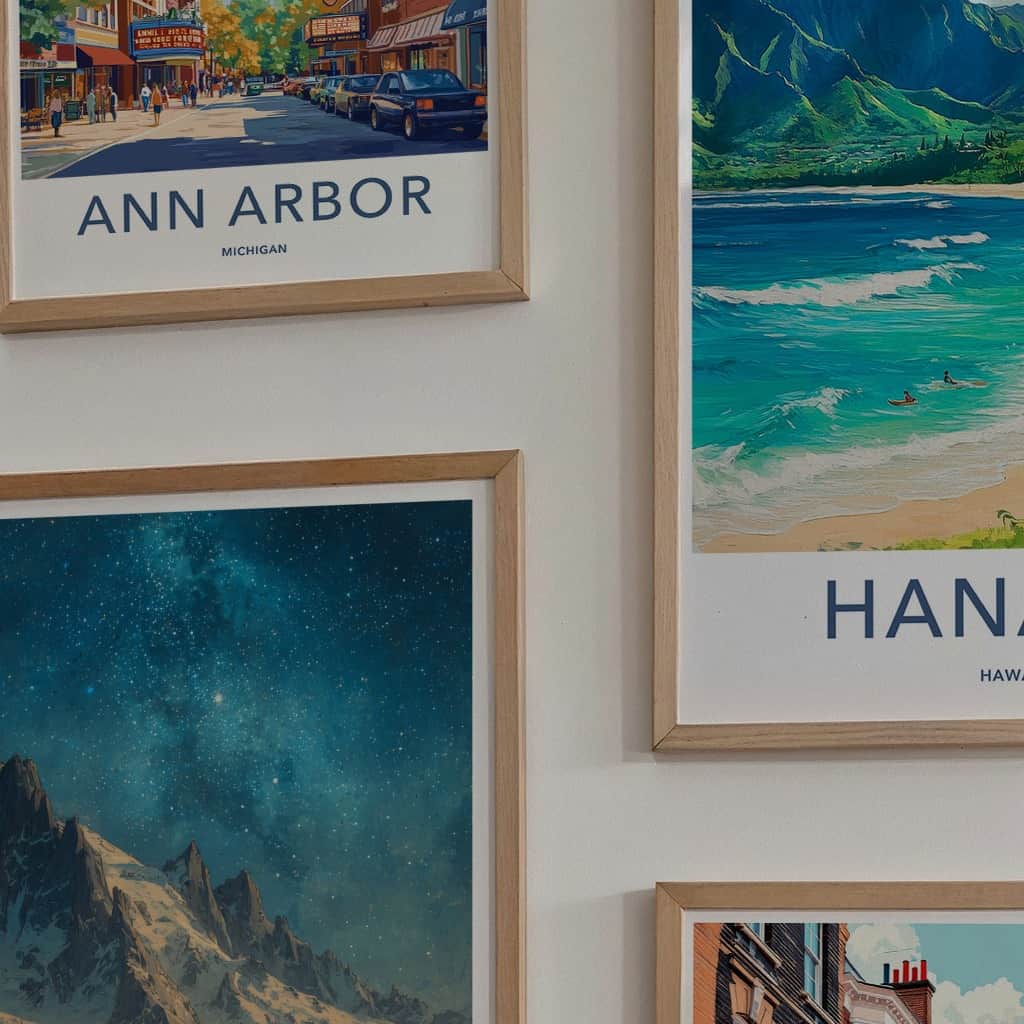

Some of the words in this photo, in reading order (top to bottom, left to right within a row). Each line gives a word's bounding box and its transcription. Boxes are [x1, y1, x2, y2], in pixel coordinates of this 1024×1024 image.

[77, 189, 204, 236] ANN
[229, 175, 432, 227] ARBOR
[221, 244, 287, 257] MICHIGAN
[826, 577, 1024, 639] HAN
[980, 669, 1024, 681] HAW
